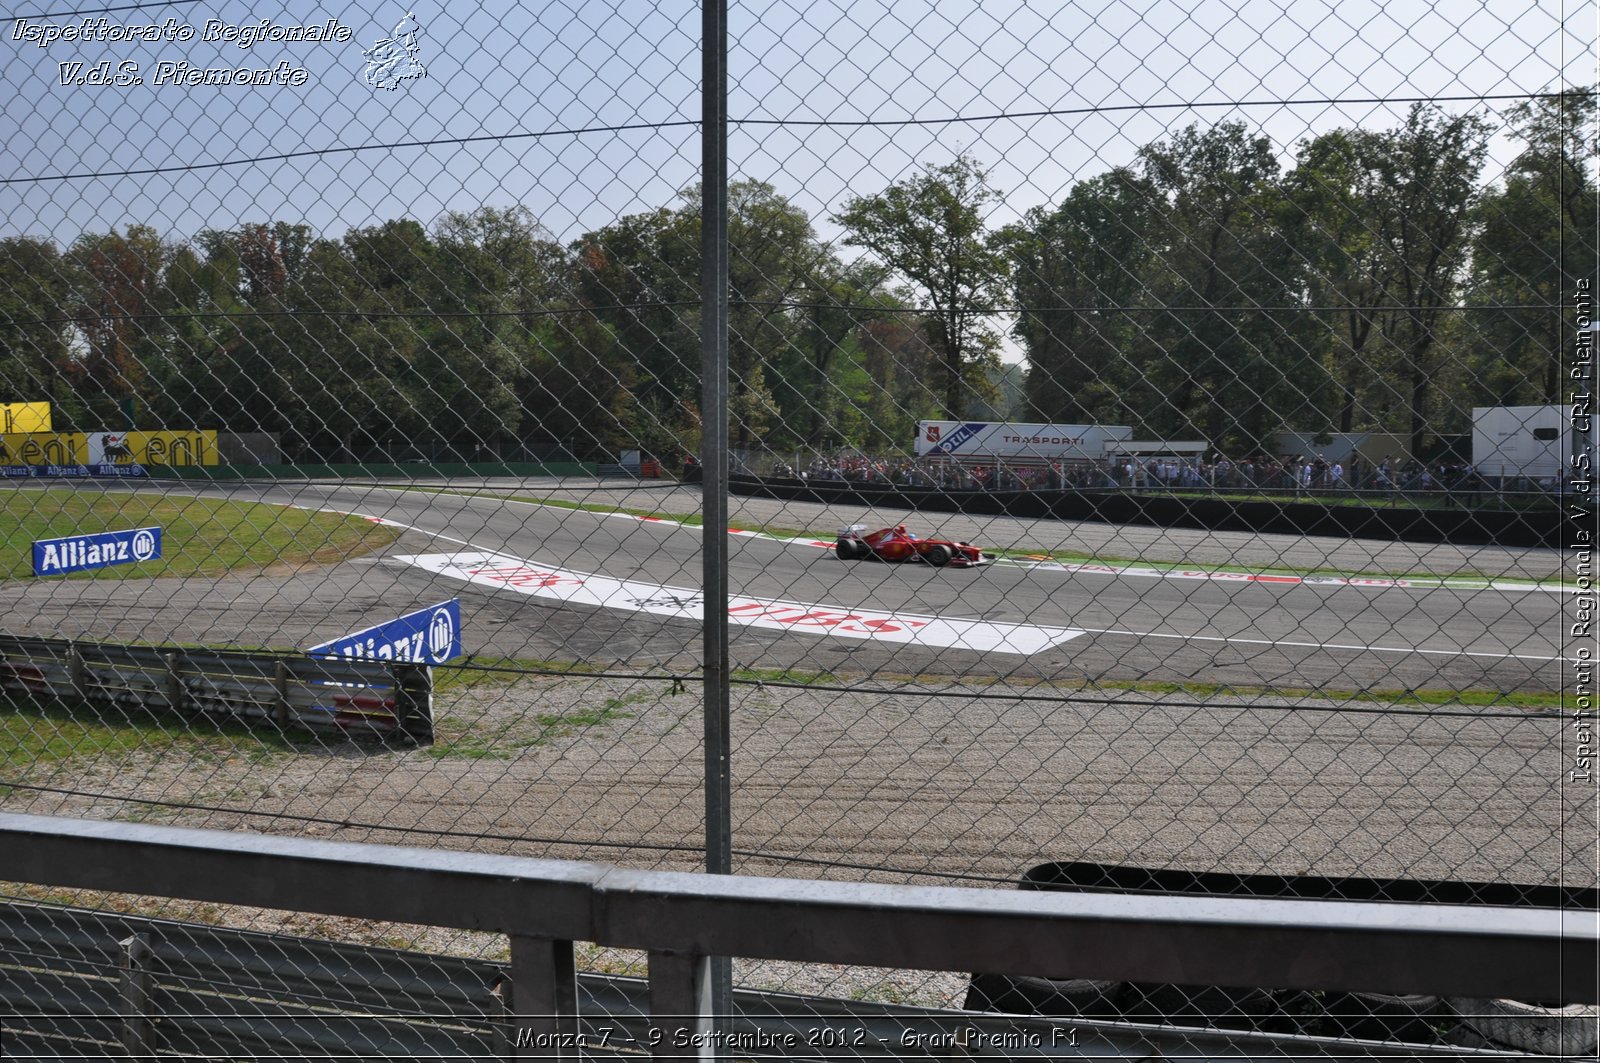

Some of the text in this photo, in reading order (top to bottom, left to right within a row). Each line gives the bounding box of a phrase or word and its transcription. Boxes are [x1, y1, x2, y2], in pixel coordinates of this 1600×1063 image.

[21, 432, 76, 466] eni
[146, 432, 203, 466] eni
[1003, 435, 1085, 446] TRASPORTI
[47, 466, 77, 476] Allianz
[99, 465, 130, 475] Allianz
[42, 540, 128, 571] Allianz
